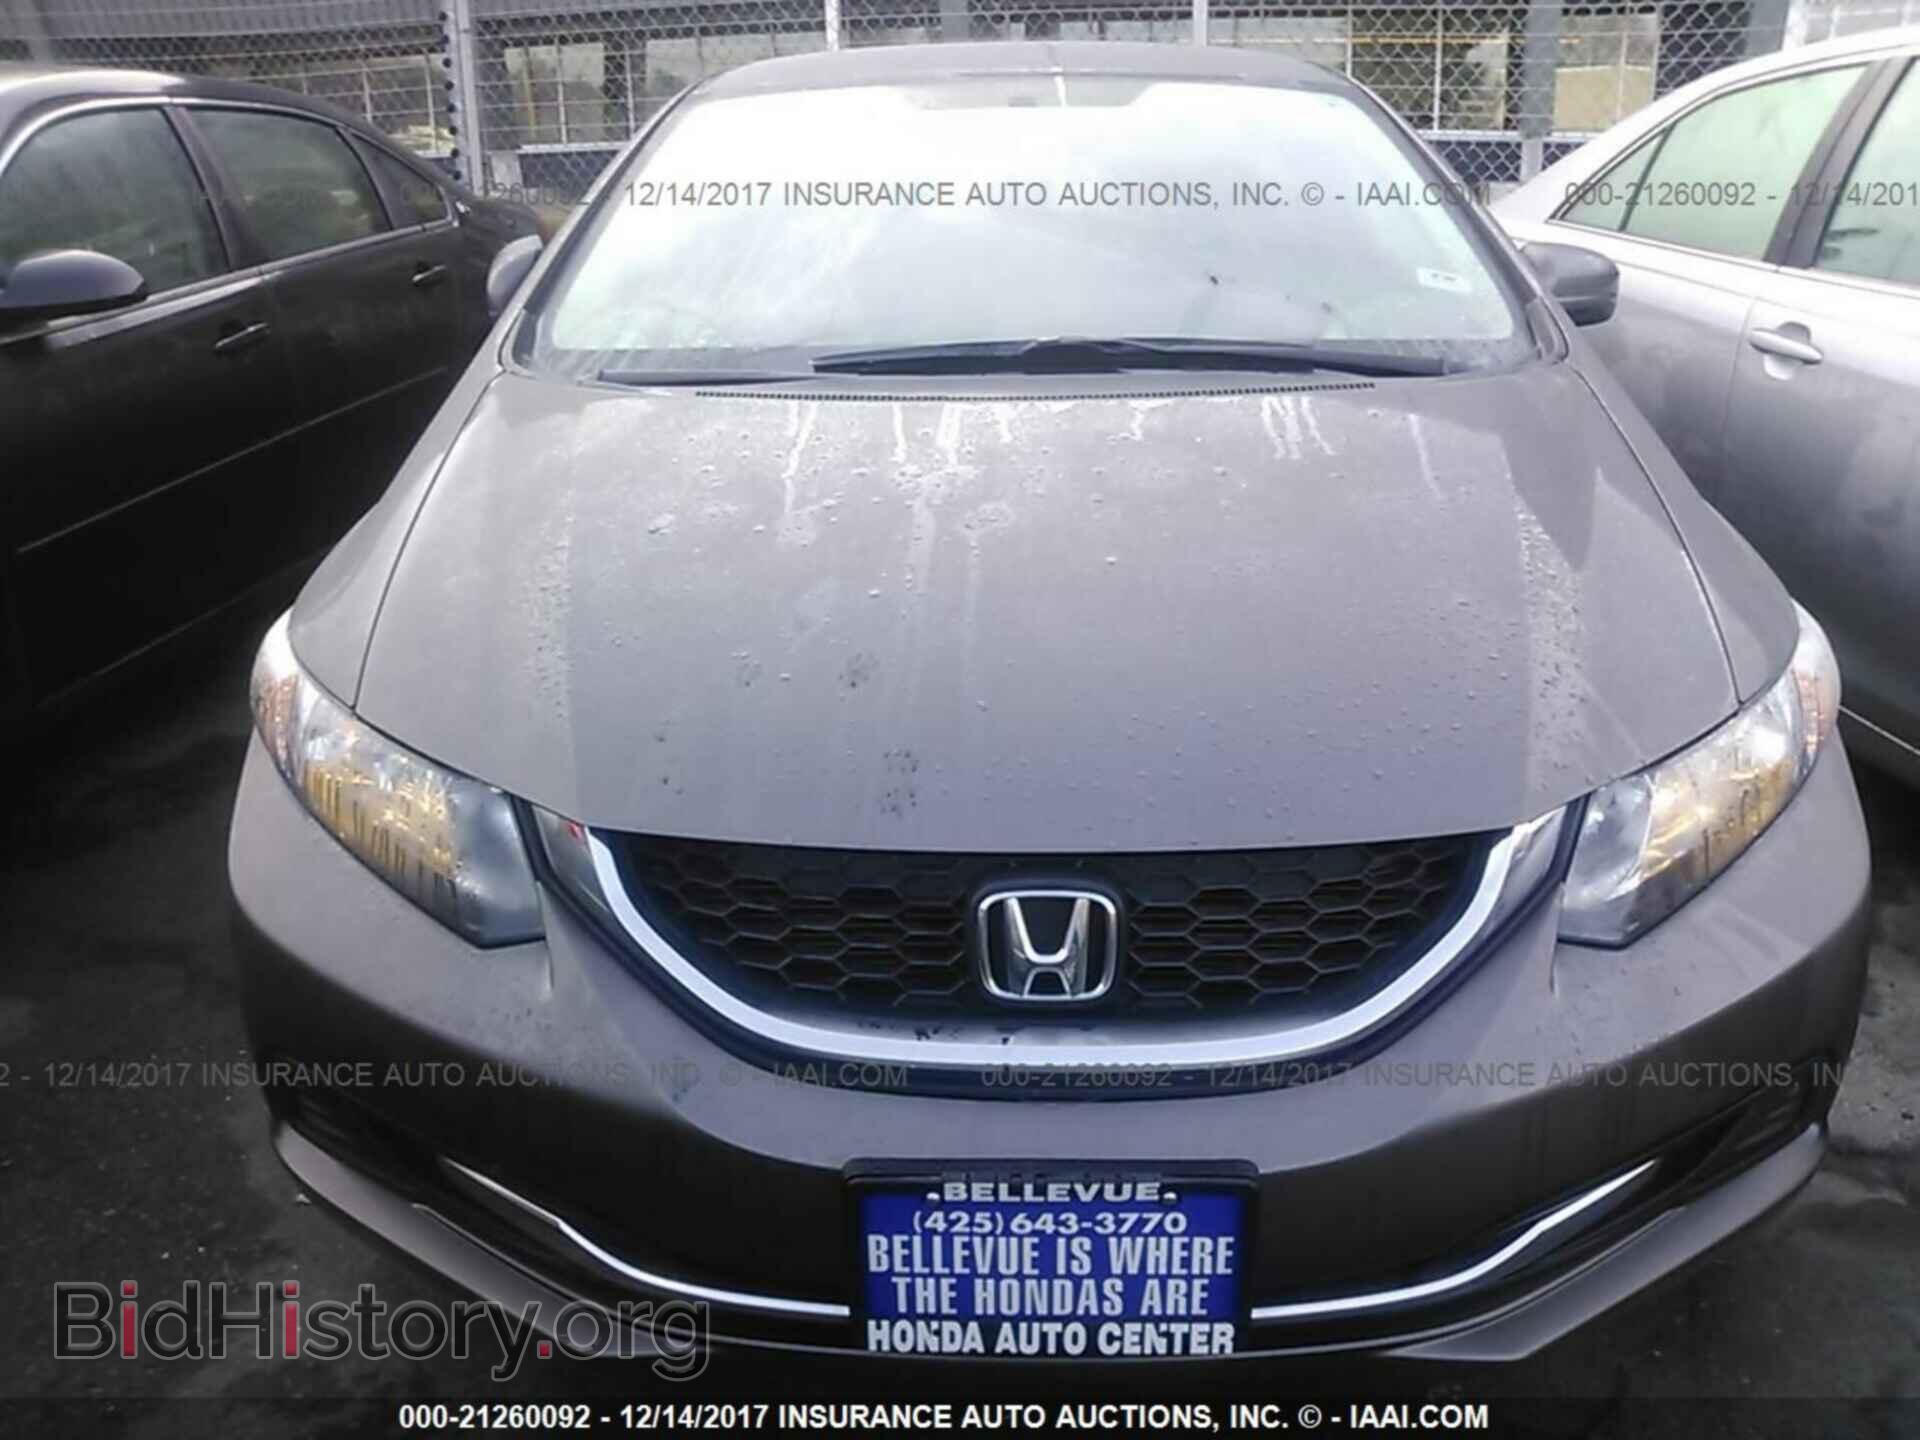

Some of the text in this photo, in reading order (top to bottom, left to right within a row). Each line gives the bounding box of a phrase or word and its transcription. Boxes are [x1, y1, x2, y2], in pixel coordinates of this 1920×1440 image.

[943, 1182, 1160, 1202] BELLEVUE
[867, 1234, 1235, 1276] BELLEVUE IS WHERE
[892, 1276, 1210, 1317] THE HONDAS ARE
[867, 1319, 1235, 1356] HONDA AUTO CENTER
